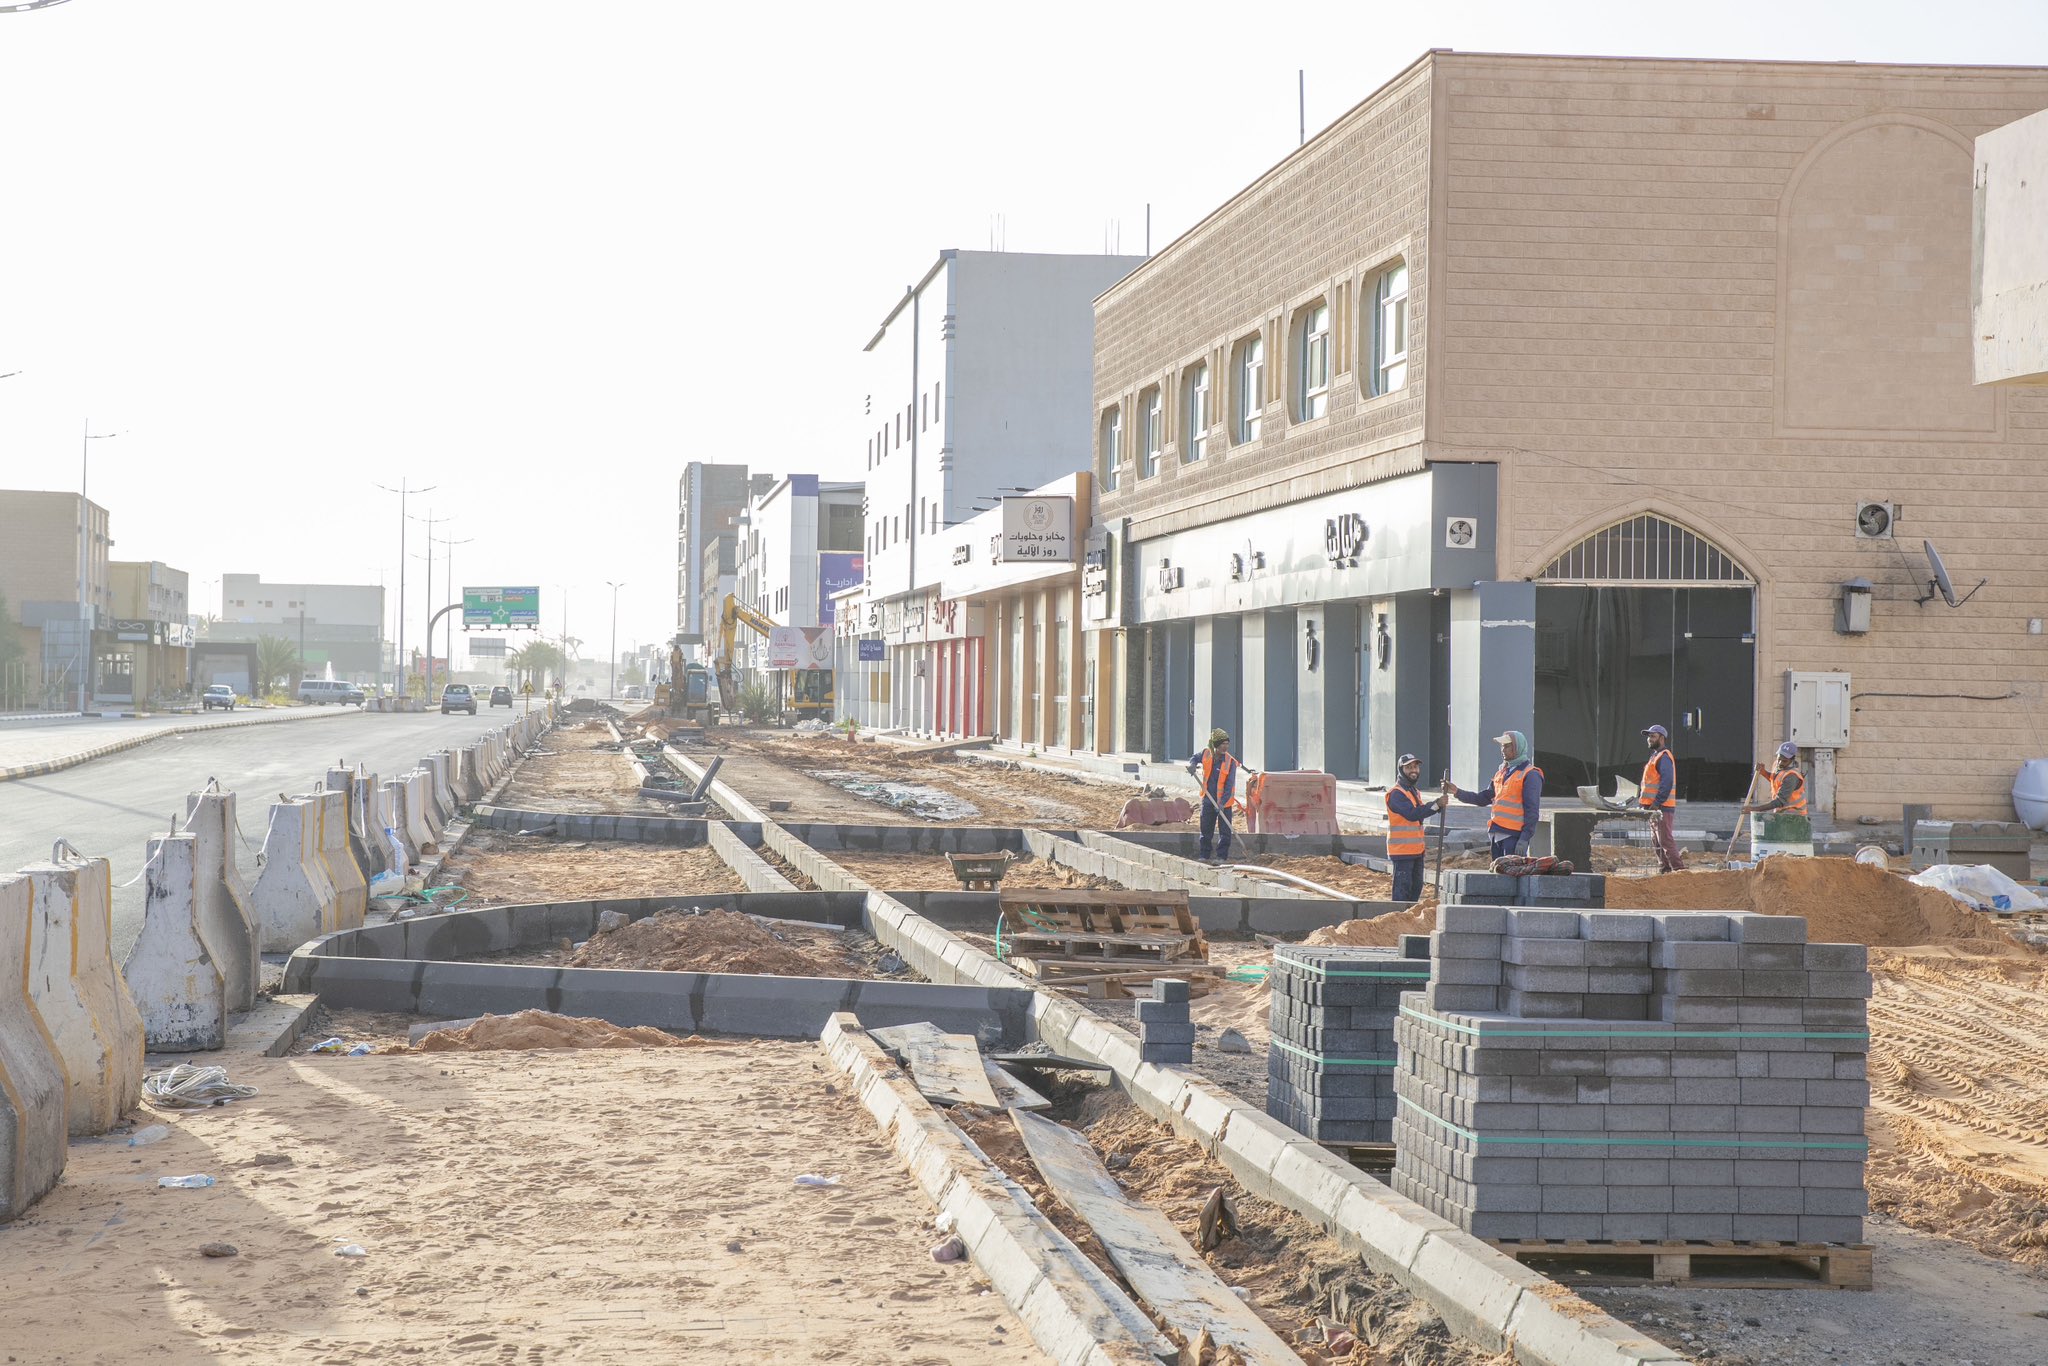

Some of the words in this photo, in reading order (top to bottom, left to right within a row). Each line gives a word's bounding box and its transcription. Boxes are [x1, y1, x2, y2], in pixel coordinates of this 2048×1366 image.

[1009, 531, 1043, 542] وحلويات
[1045, 531, 1066, 542] مخابز
[1017, 544, 1040, 557] الآلية
[1043, 547, 1057, 557] روز
